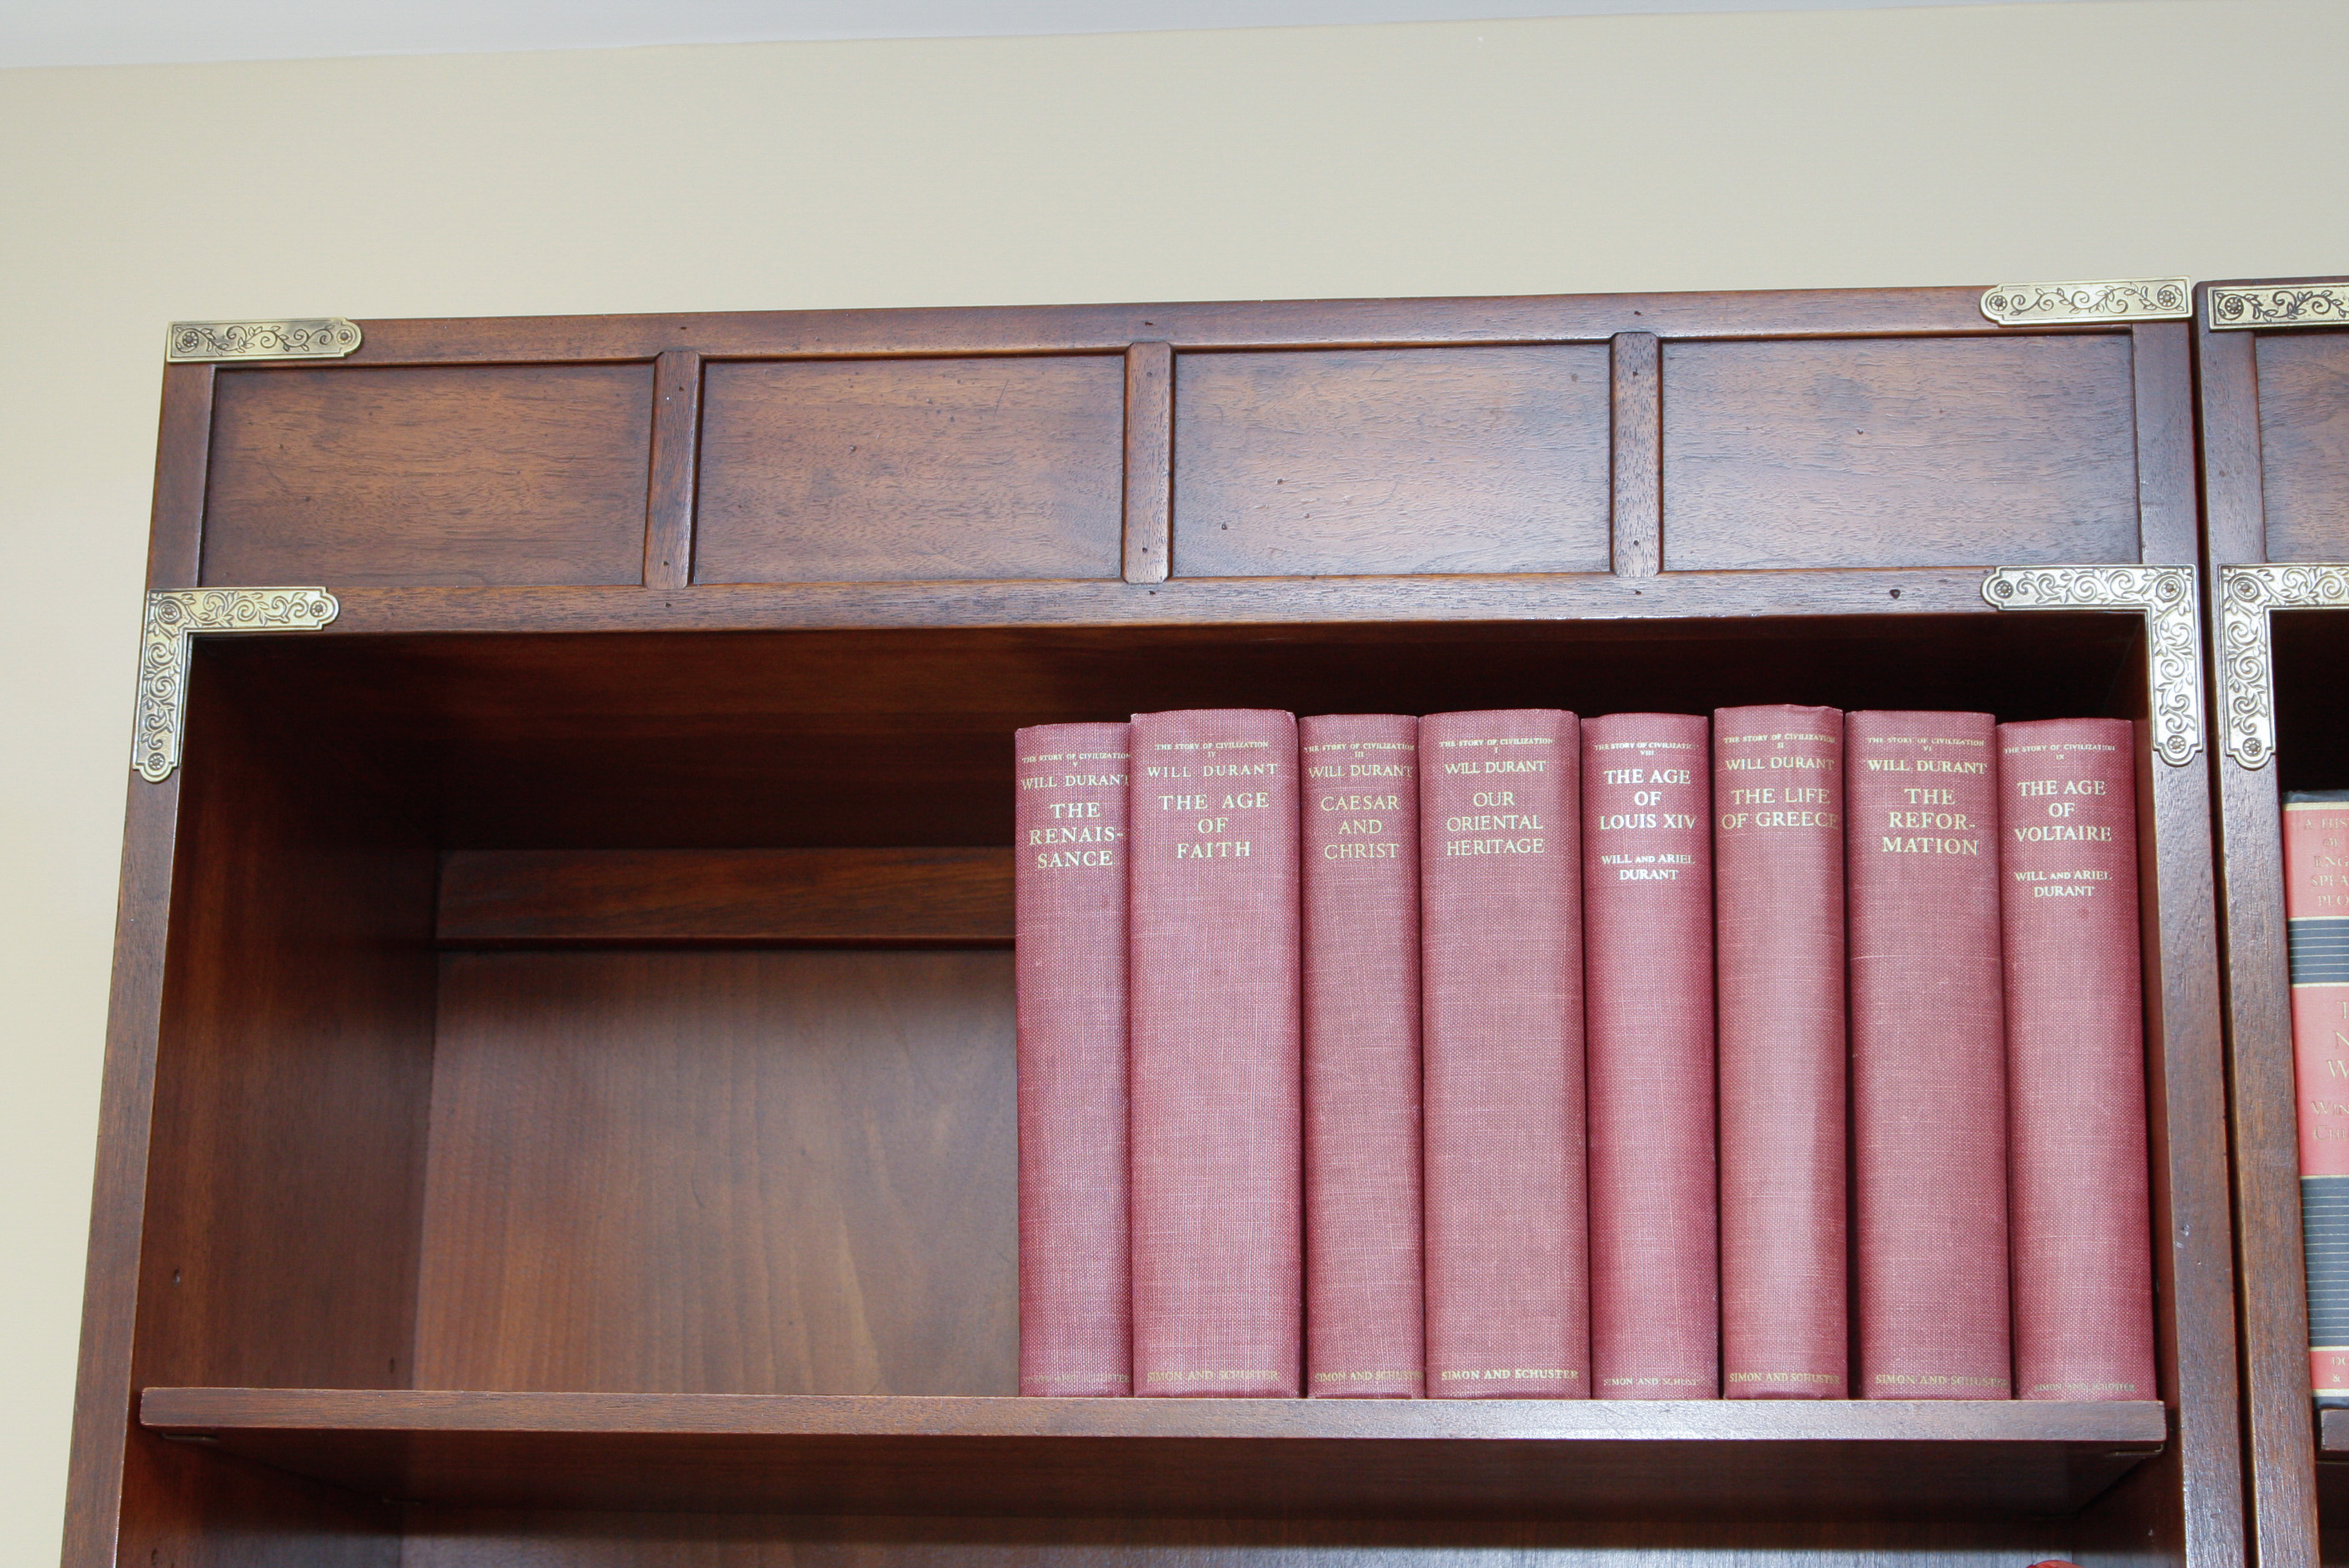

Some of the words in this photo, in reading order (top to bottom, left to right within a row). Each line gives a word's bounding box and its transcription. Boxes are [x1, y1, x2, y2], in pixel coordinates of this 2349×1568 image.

[1147, 766, 1191, 778] WILL
[1203, 763, 1278, 776] DURANT
[1445, 761, 1480, 774] WILL
[1486, 761, 1547, 772] DURANT
[1726, 759, 1765, 770] WILL
[1772, 757, 1834, 770] DURANT
[1868, 760, 1909, 771] WILL
[1917, 761, 1987, 774] DURANT
[1309, 766, 1345, 778] WILL
[1351, 765, 1413, 777] DURANT
[1604, 769, 1645, 784] THE
[1650, 770, 1691, 784] AGE
[1021, 776, 1057, 791] WILL
[2018, 782, 2057, 796] THE
[2063, 781, 2105, 795] AGE
[1158, 794, 1208, 811] THE
[1222, 792, 1270, 808] AGE
[1320, 795, 1400, 812] CAESAR
[1473, 792, 1515, 807] OUR
[1634, 792, 1662, 806] OF
[1731, 789, 1775, 805] THE
[1784, 788, 1830, 804] LIFE
[1904, 788, 1955, 805] THE
[1049, 802, 1101, 818] THE
[2049, 803, 2075, 817] OF
[1198, 818, 1229, 834] OF
[1339, 820, 1381, 834] AND
[1446, 815, 1543, 832] ORIENTAL
[1599, 814, 1656, 830] LOUIS
[1663, 814, 1696, 829] XIV
[1722, 814, 1748, 829] OF
[1755, 812, 1838, 830] GREECE
[1889, 812, 1975, 830] REFOR-
[1029, 827, 1124, 846] RENAIS-
[2015, 826, 2111, 842] VOLTAIRE
[1176, 842, 1250, 858] FAITH
[1324, 843, 1399, 859] CHRIST
[1446, 838, 1544, 856] HERITAGE
[1882, 837, 1979, 855] MATION
[1038, 851, 1113, 868] SANCE
[1602, 855, 1632, 864] WILL
[1658, 854, 1695, 864] ARIEL
[1619, 869, 1678, 881] DURANT
[2015, 872, 2046, 881] WILL
[2074, 871, 2111, 881] ARIEL
[2034, 886, 2095, 897] DURANT
[1147, 1371, 1183, 1383] SIMON
[1188, 1370, 1214, 1380] AND
[1351, 1372, 1372, 1380] AND
[1441, 1370, 1479, 1380] SIMON
[1485, 1369, 1511, 1379] AND
[1515, 1369, 1578, 1380] SCHUSTER
[1729, 1374, 1762, 1382] SIMON
[1766, 1374, 1788, 1382] AND
[1791, 1374, 1840, 1385] SCHUSTER
[1876, 1375, 1915, 1384] SIMON
[1920, 1376, 1946, 1385] AND
